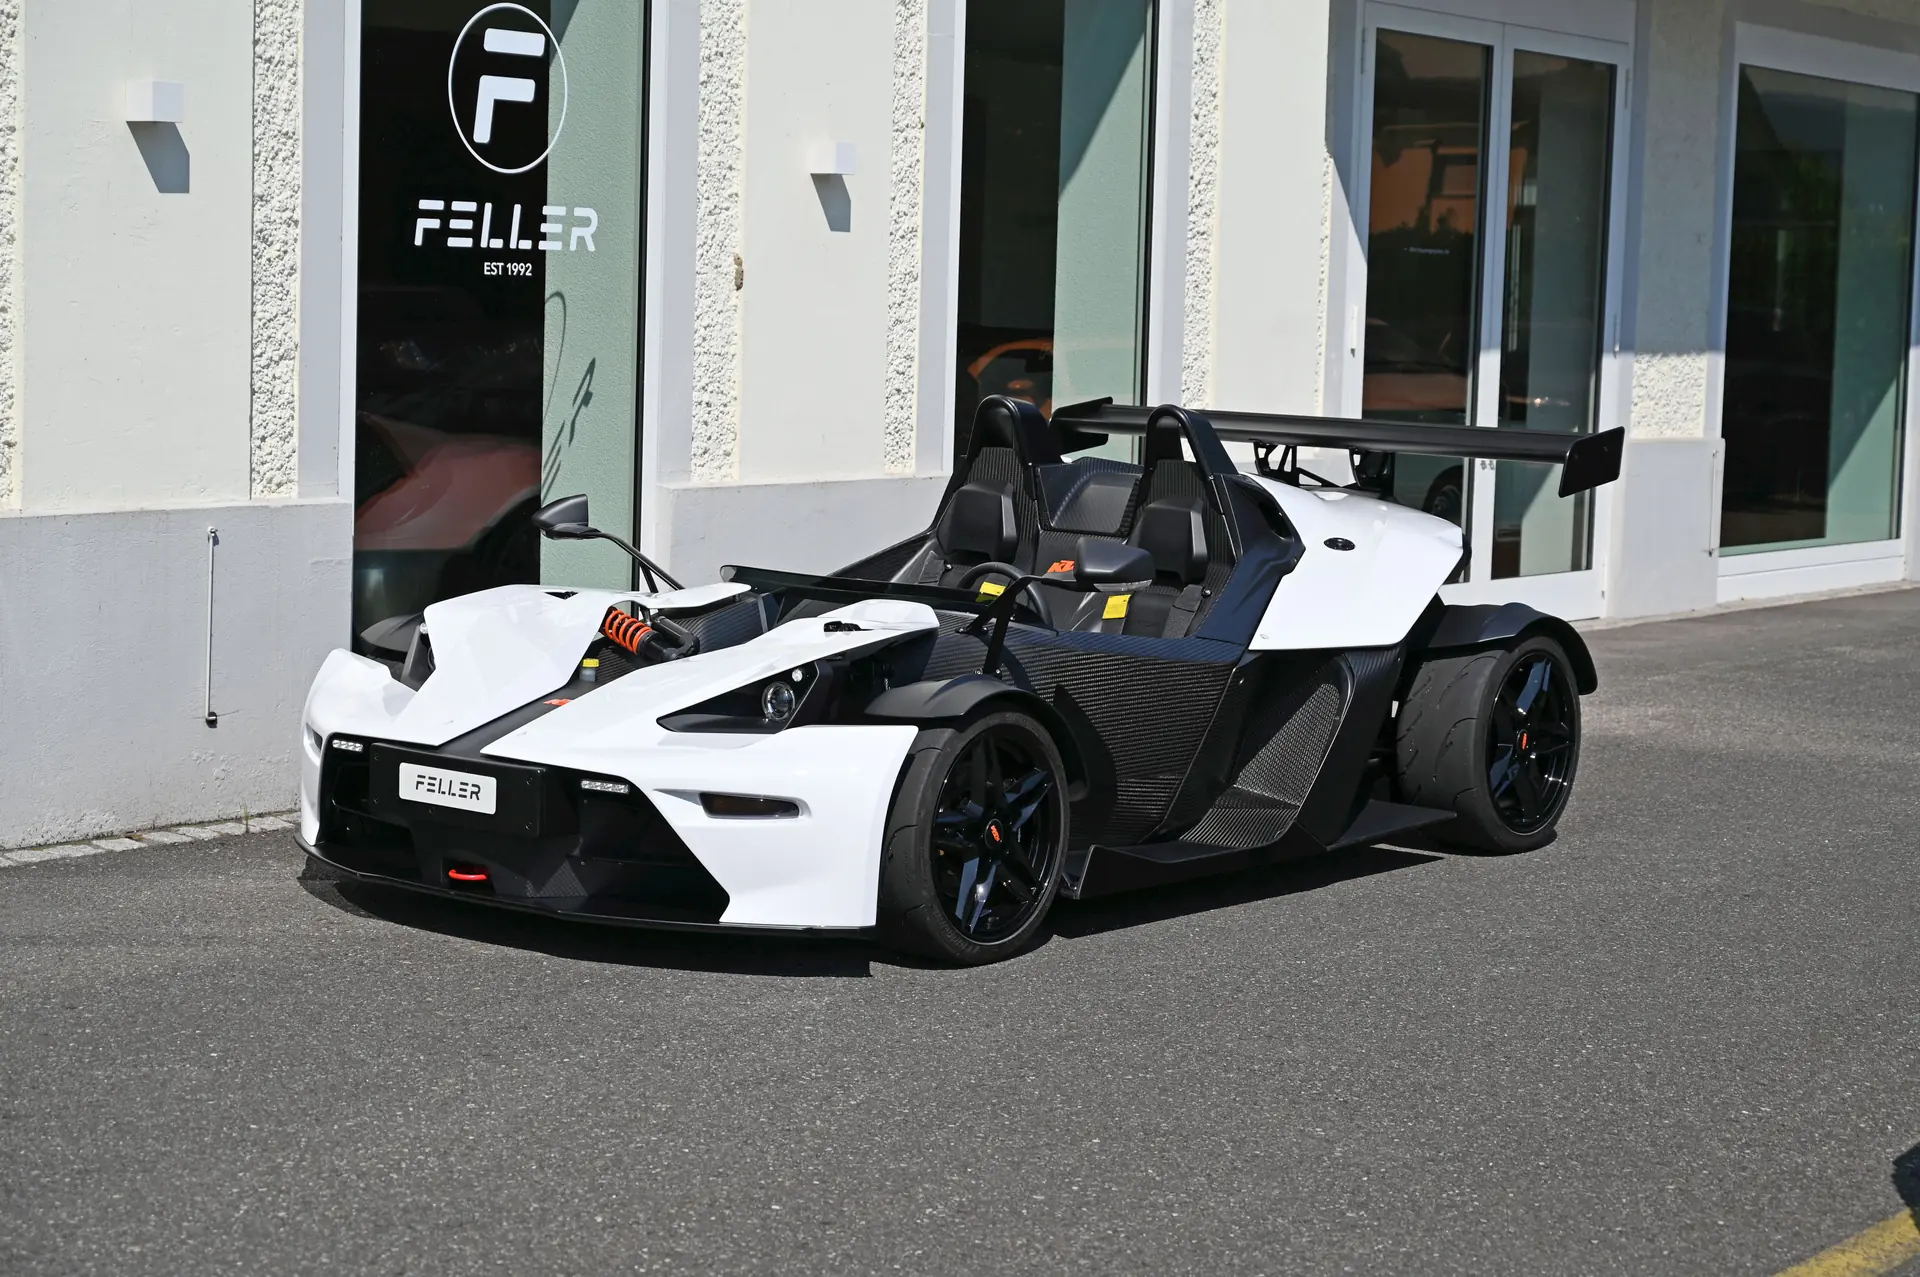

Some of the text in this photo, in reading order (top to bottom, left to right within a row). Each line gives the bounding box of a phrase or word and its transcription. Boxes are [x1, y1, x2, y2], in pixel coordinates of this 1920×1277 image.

[473, 27, 546, 144] F
[414, 199, 598, 251] FELLER
[483, 261, 532, 276] EST 1992
[415, 774, 481, 801] FELLER
